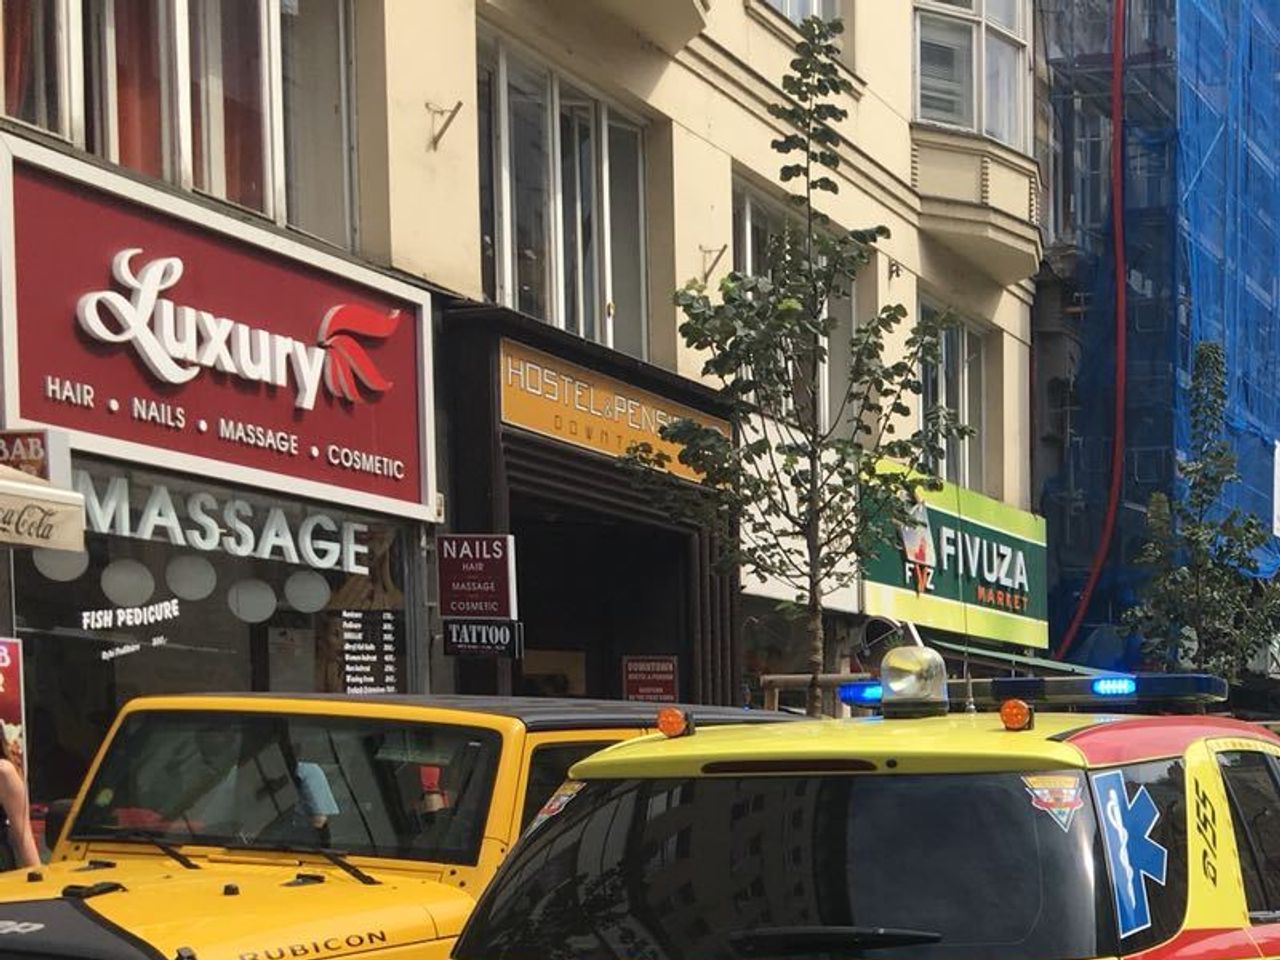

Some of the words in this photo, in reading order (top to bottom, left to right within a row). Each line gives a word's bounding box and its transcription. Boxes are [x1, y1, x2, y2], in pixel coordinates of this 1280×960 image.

[77, 248, 326, 411] Luxury
[508, 356, 601, 417] HOSTEL
[46, 375, 95, 408] HAIR
[132, 397, 187, 430] NAILS
[218, 418, 300, 455] MASSAGE
[327, 444, 406, 479] COSMETIC
[75, 469, 370, 576] MASSAGE
[443, 540, 504, 559] NAILS
[941, 525, 1030, 592] FIVUZA
[462, 562, 485, 572] HAIR
[452, 582, 496, 592] MASSAGE
[976, 584, 1029, 613] MARKET
[82, 609, 114, 630] FISH
[116, 598, 180, 627] PEDICURE
[450, 601, 500, 611] COSMETIC
[448, 624, 511, 645] TATTOO
